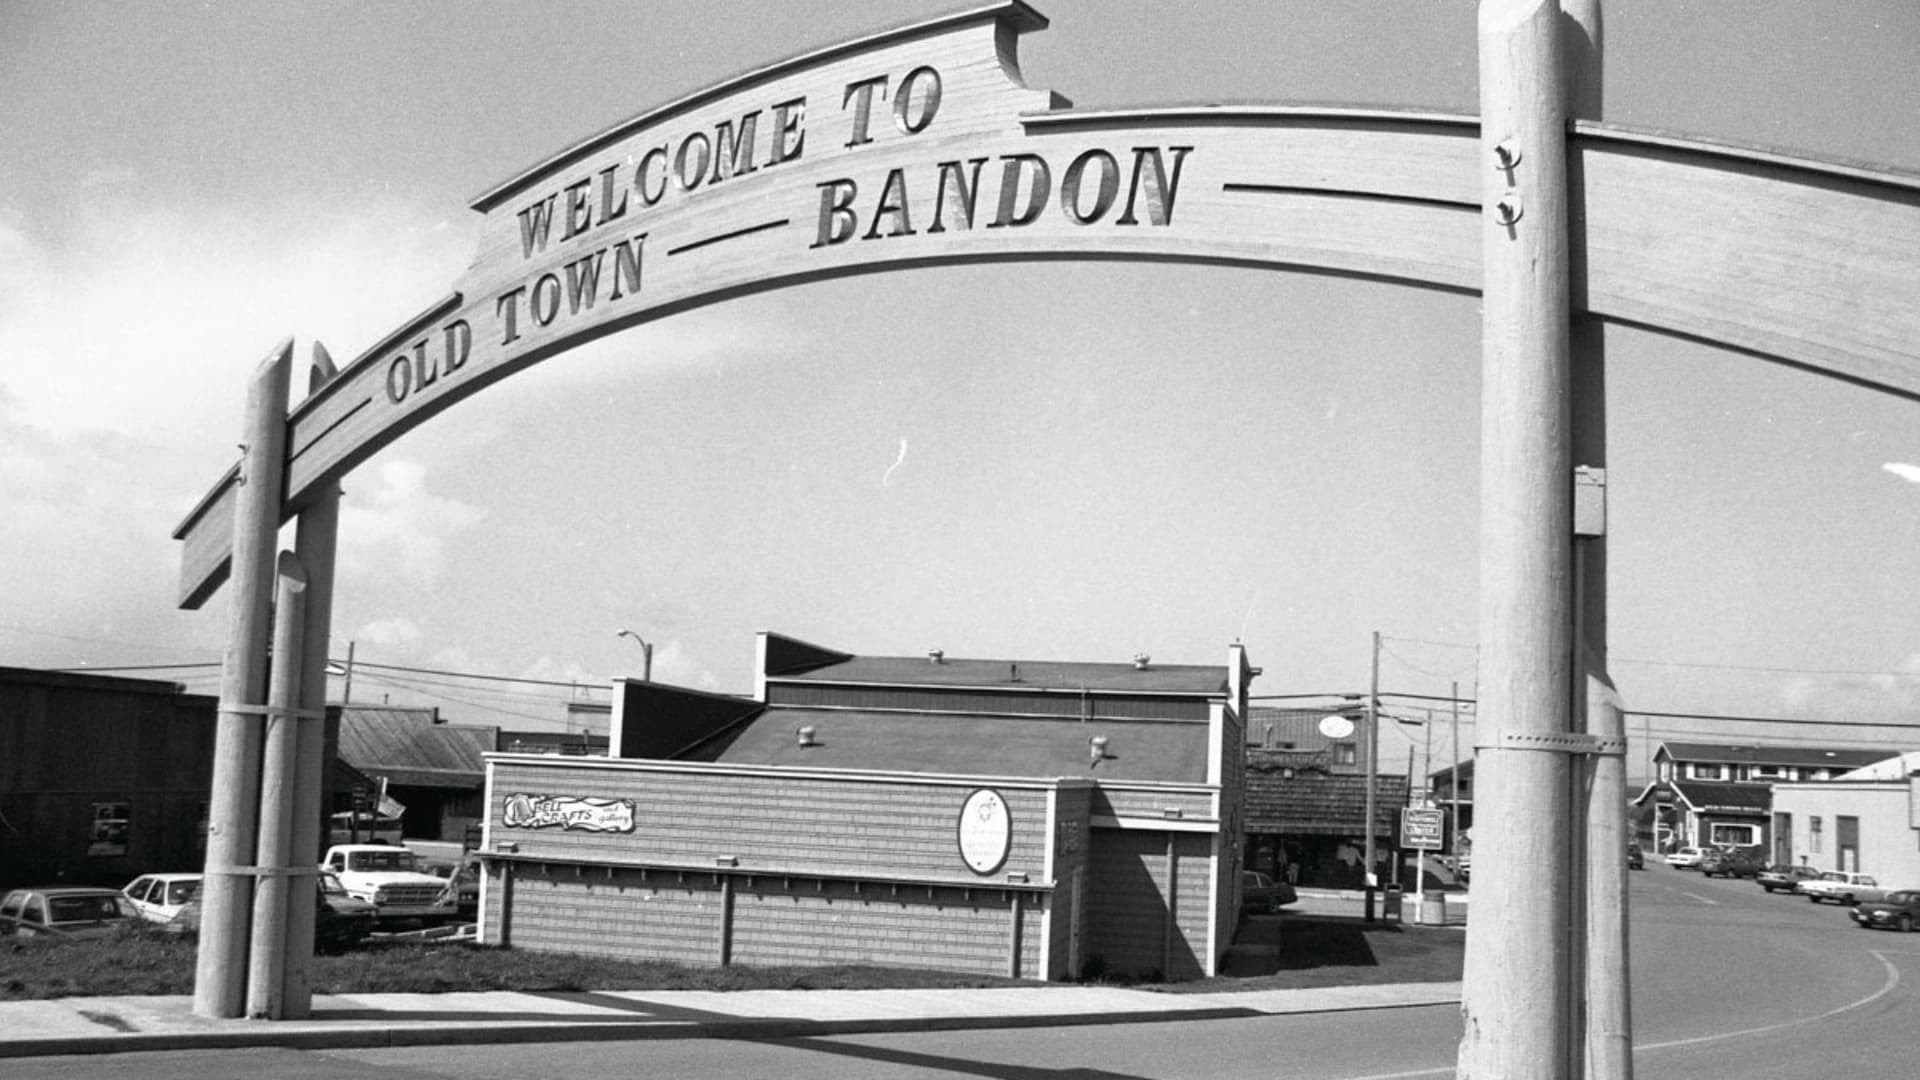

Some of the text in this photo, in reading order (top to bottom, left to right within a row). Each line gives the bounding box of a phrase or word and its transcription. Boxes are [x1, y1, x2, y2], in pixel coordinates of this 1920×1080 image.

[386, 146, 1195, 404] OLD TOWN BANDON
[517, 65, 943, 259] WELCOME TO
